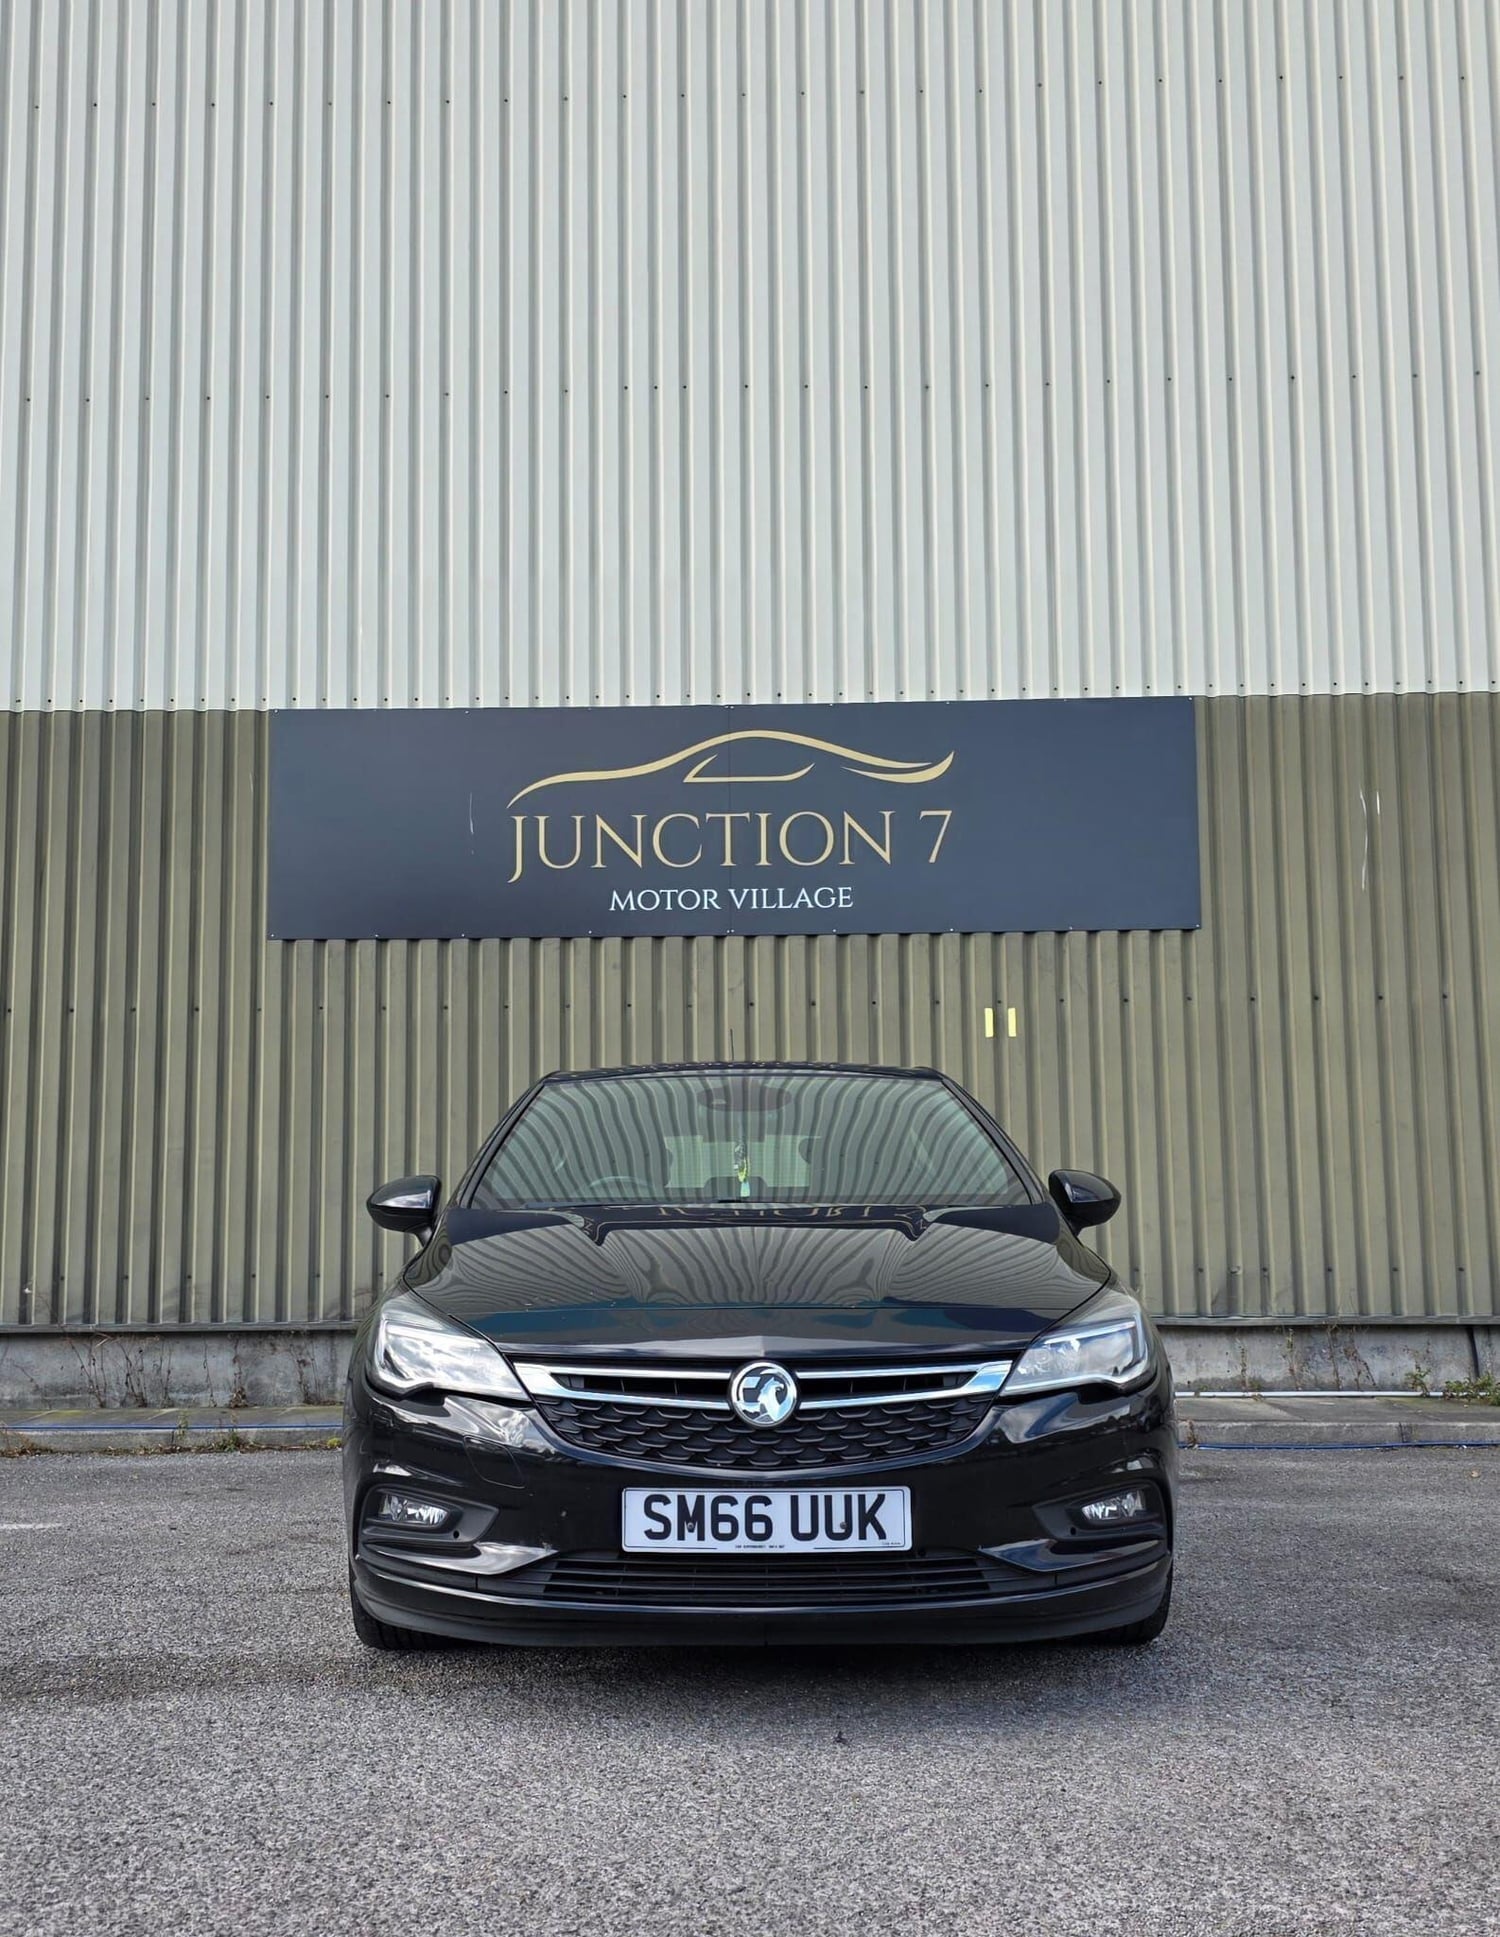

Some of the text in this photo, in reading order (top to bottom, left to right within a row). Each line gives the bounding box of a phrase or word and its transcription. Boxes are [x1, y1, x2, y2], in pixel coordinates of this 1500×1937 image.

[508, 809, 953, 884] JUNCTION 7
[609, 886, 854, 912] MOTOR VILLAGE
[643, 1493, 887, 1542] SM66 UUK
